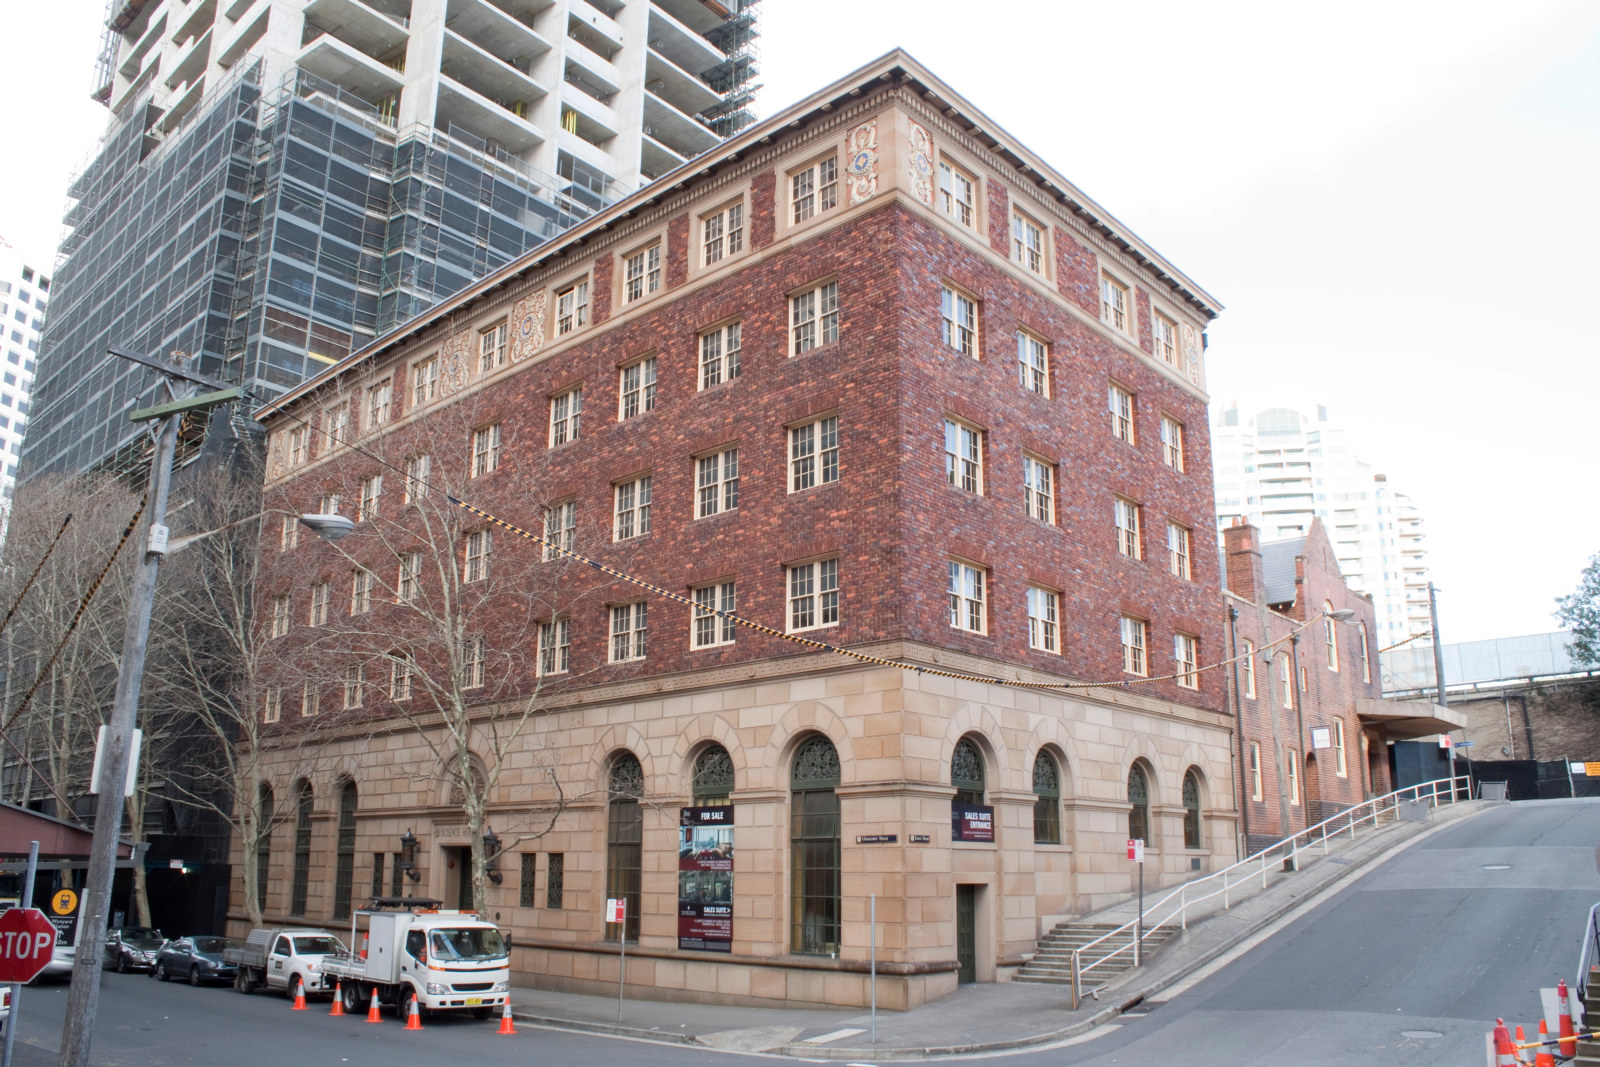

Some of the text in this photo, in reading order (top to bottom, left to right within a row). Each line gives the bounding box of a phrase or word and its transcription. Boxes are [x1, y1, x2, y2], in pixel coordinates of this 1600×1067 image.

[701, 812, 711, 820] FOR
[711, 811, 724, 820] SALE
[965, 811, 978, 820] SALES
[979, 812, 992, 821] SUITE
[970, 821, 992, 830] ENTRANCE
[716, 906, 726, 914] SUITE
[0, 931, 51, 959] TOP
